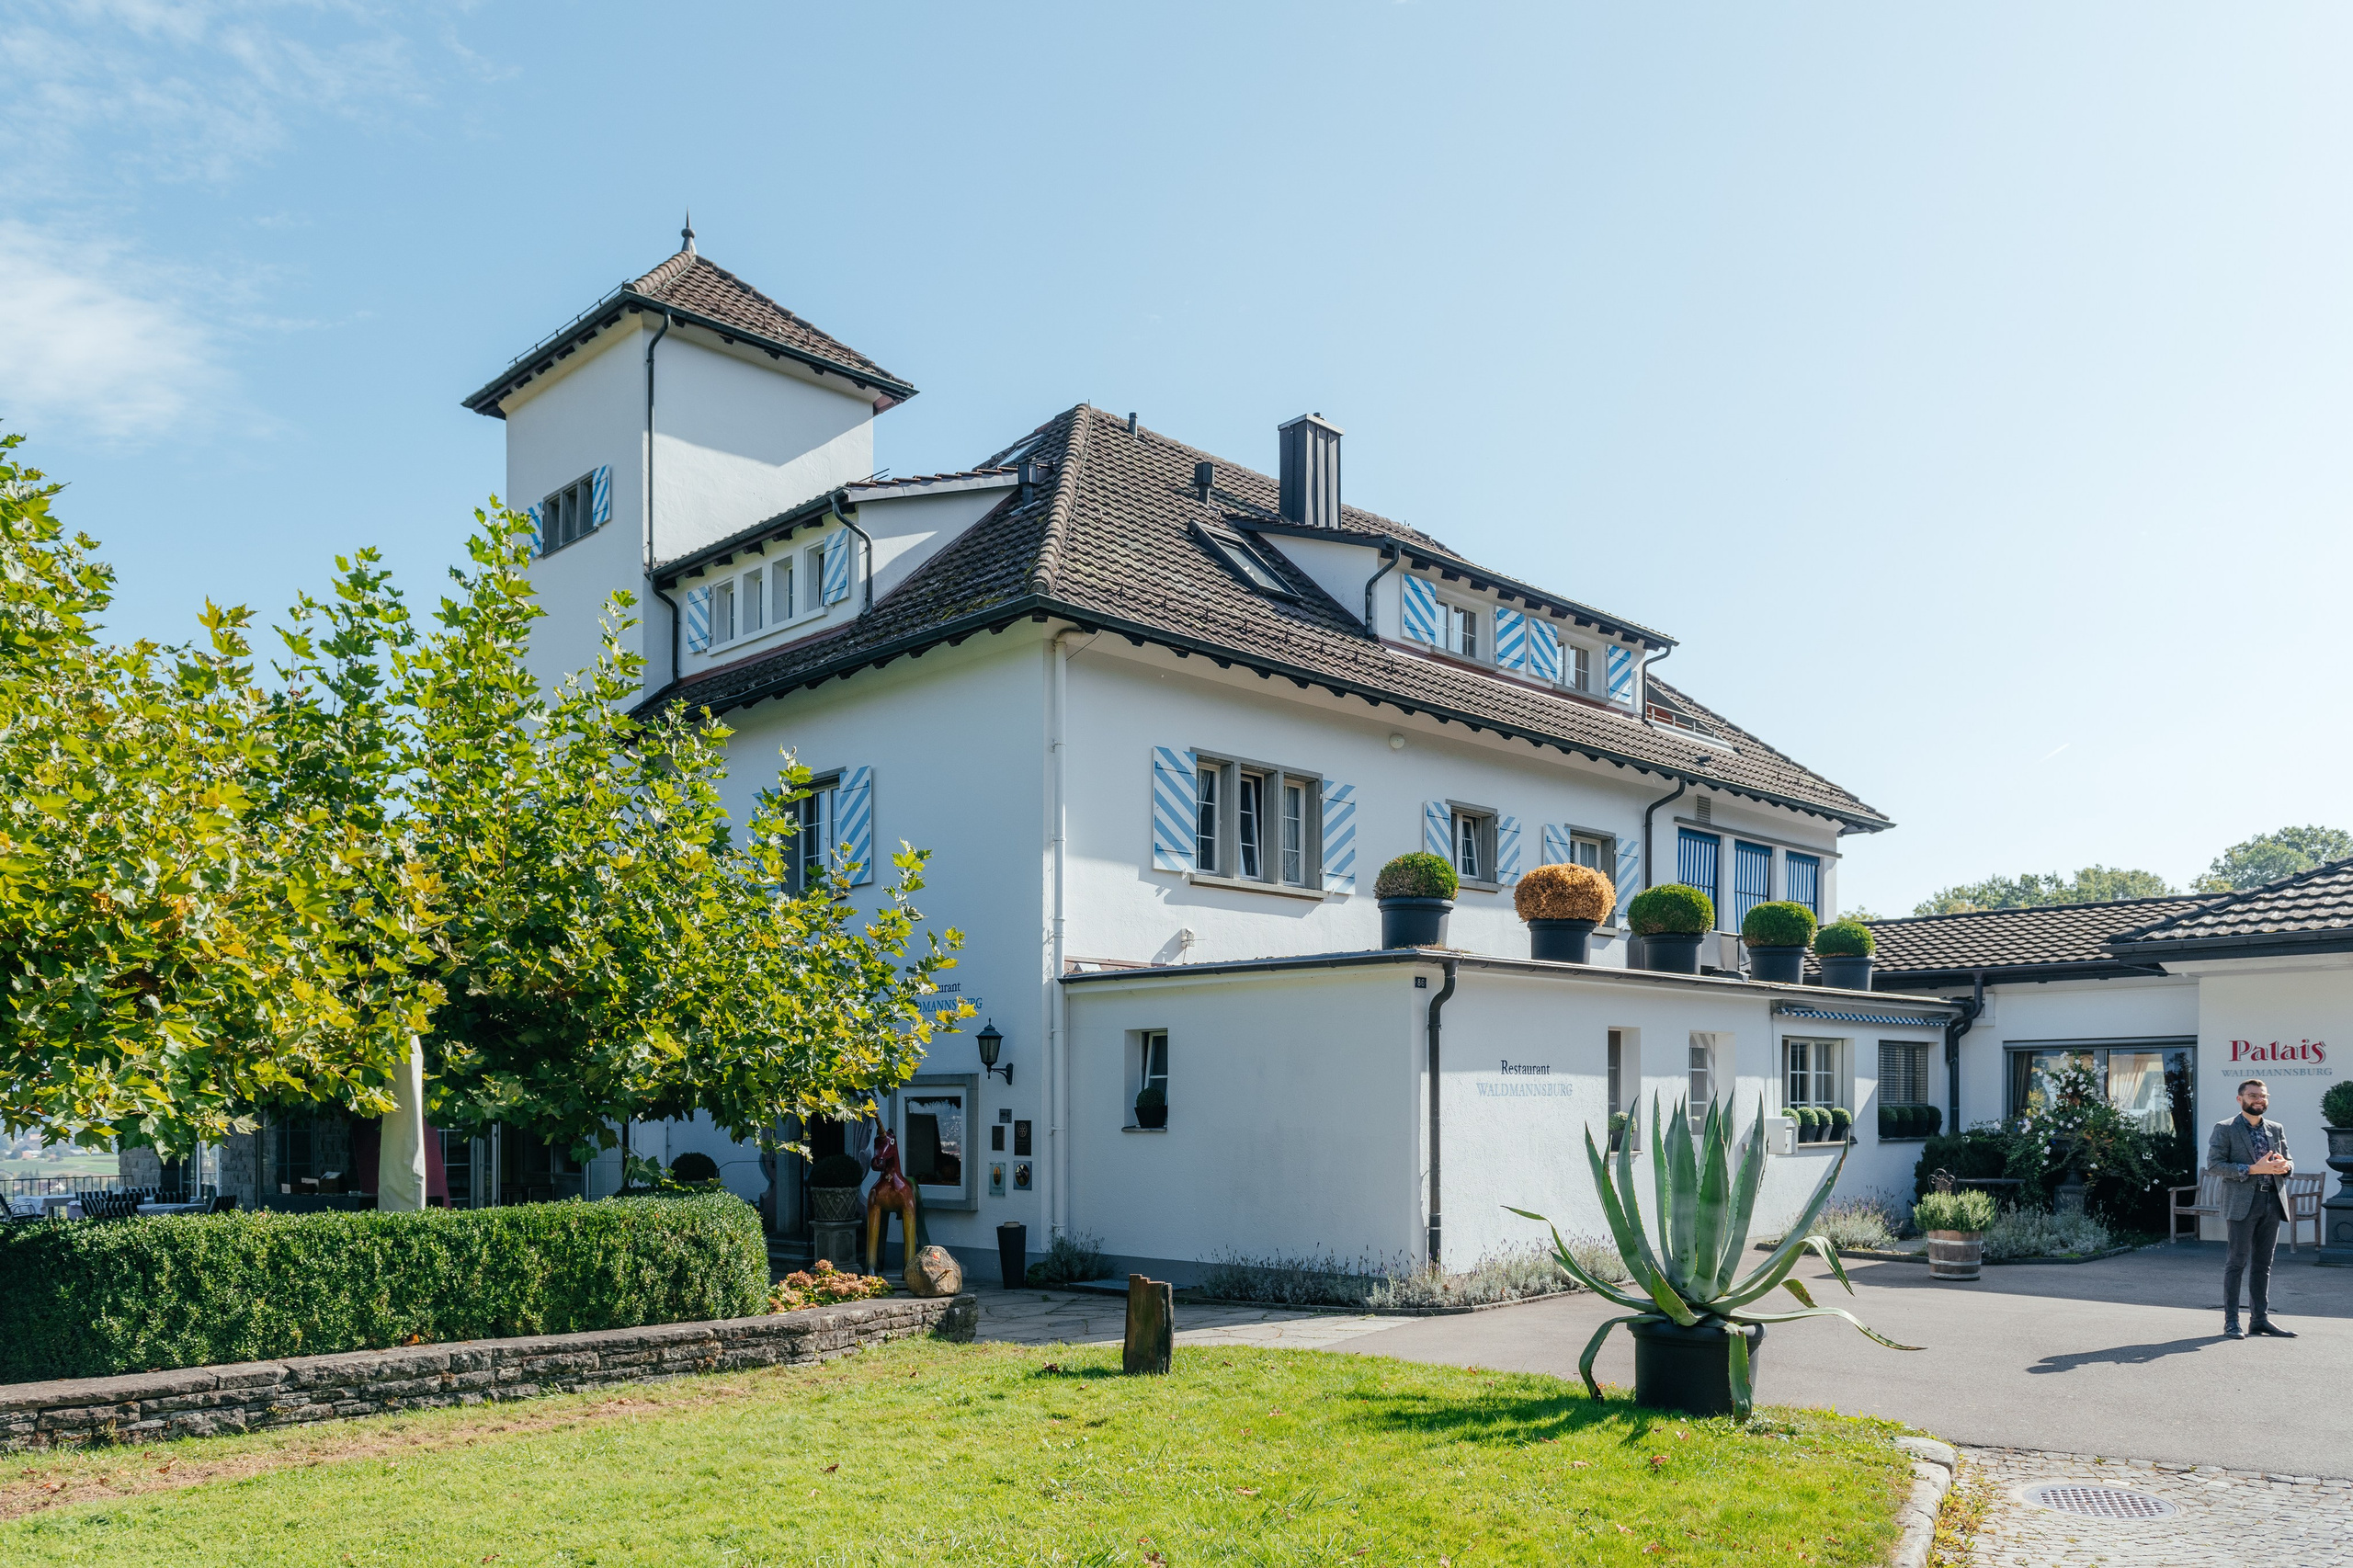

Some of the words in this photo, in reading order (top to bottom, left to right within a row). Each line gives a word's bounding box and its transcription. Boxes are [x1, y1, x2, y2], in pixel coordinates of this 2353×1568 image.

[2228, 1039, 2326, 1064] Palais
[1500, 1060, 1551, 1075] Restaurant
[2222, 1068, 2333, 1077] WALDMANNSBURG
[1476, 1083, 1574, 1097] WALDMANNSBURG
